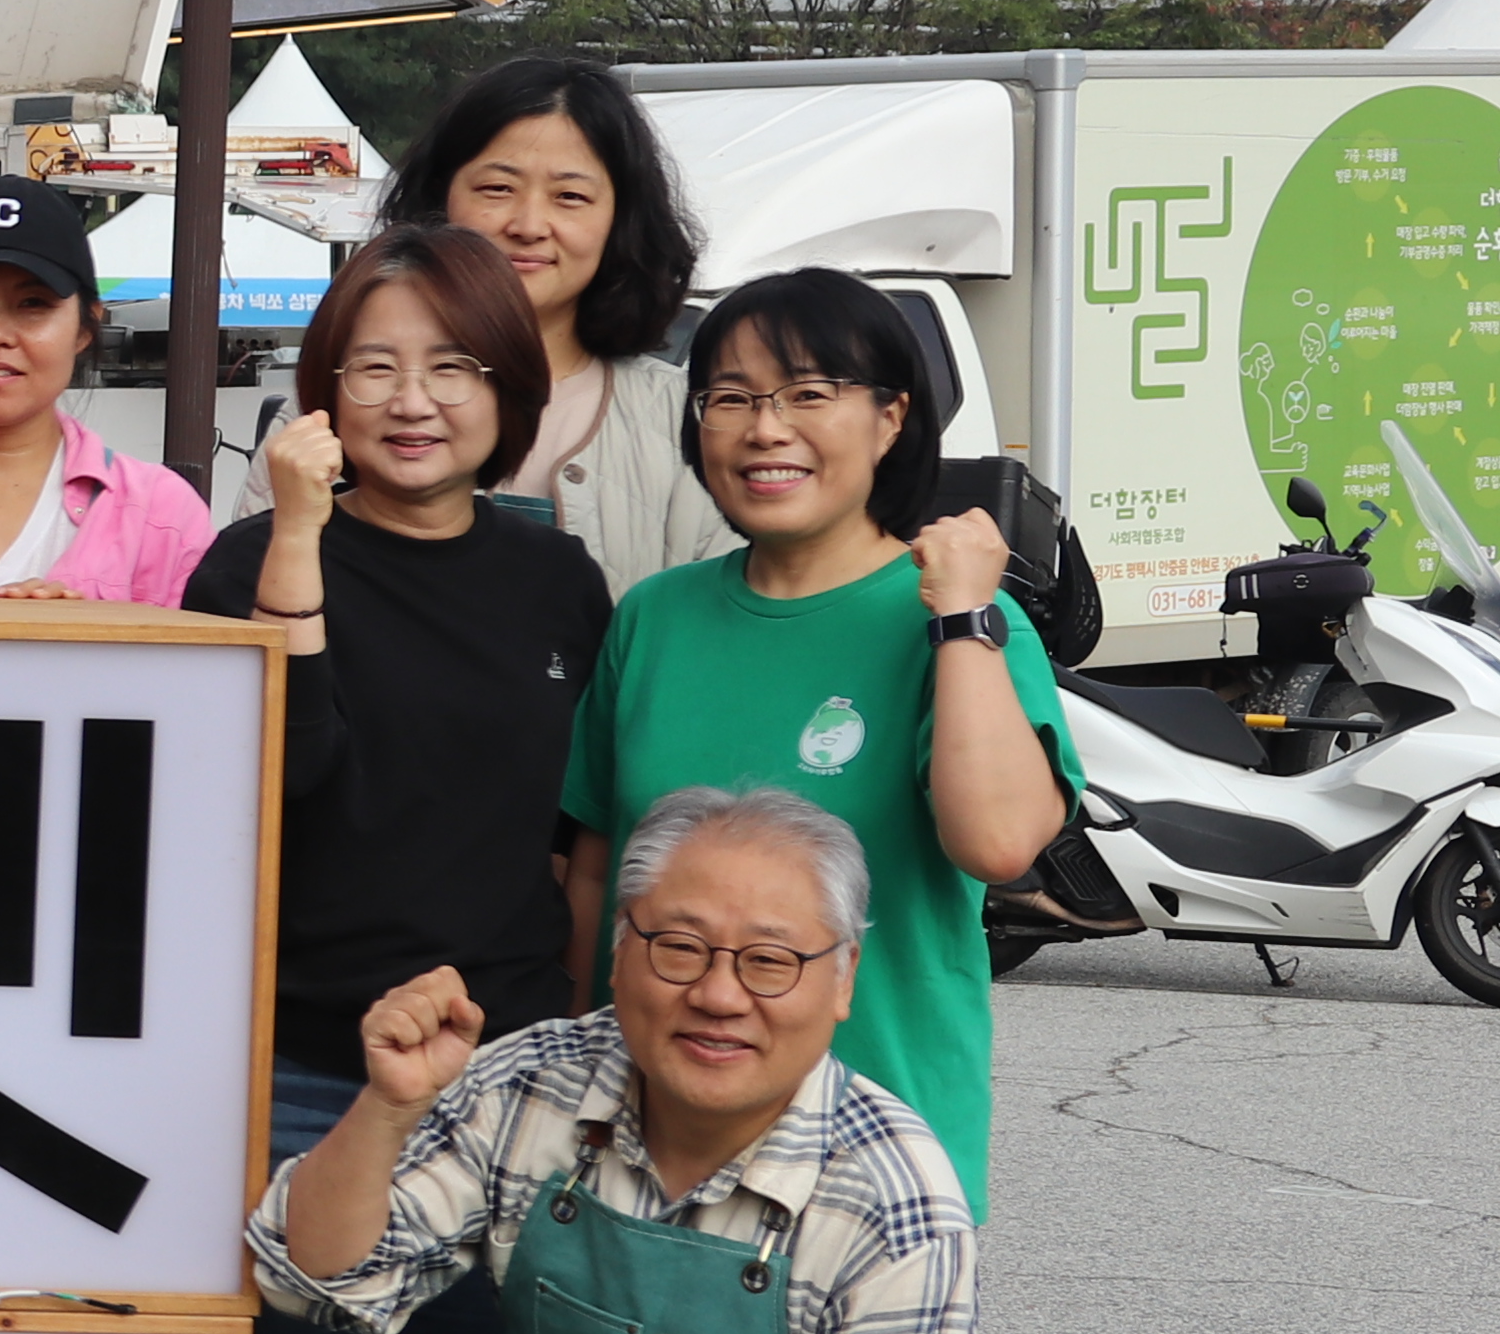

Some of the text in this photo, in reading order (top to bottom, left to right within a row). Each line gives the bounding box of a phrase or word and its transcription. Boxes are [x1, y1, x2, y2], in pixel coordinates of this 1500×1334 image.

[1090, 488, 1186, 520] 더함장터
[1108, 527, 1185, 546] 사회적협동조합
[1094, 563, 1124, 582] 경기도
[1126, 560, 1157, 580] 평택시
[1158, 558, 1189, 577] 안중읍
[1152, 589, 1226, 612] 031-681-
